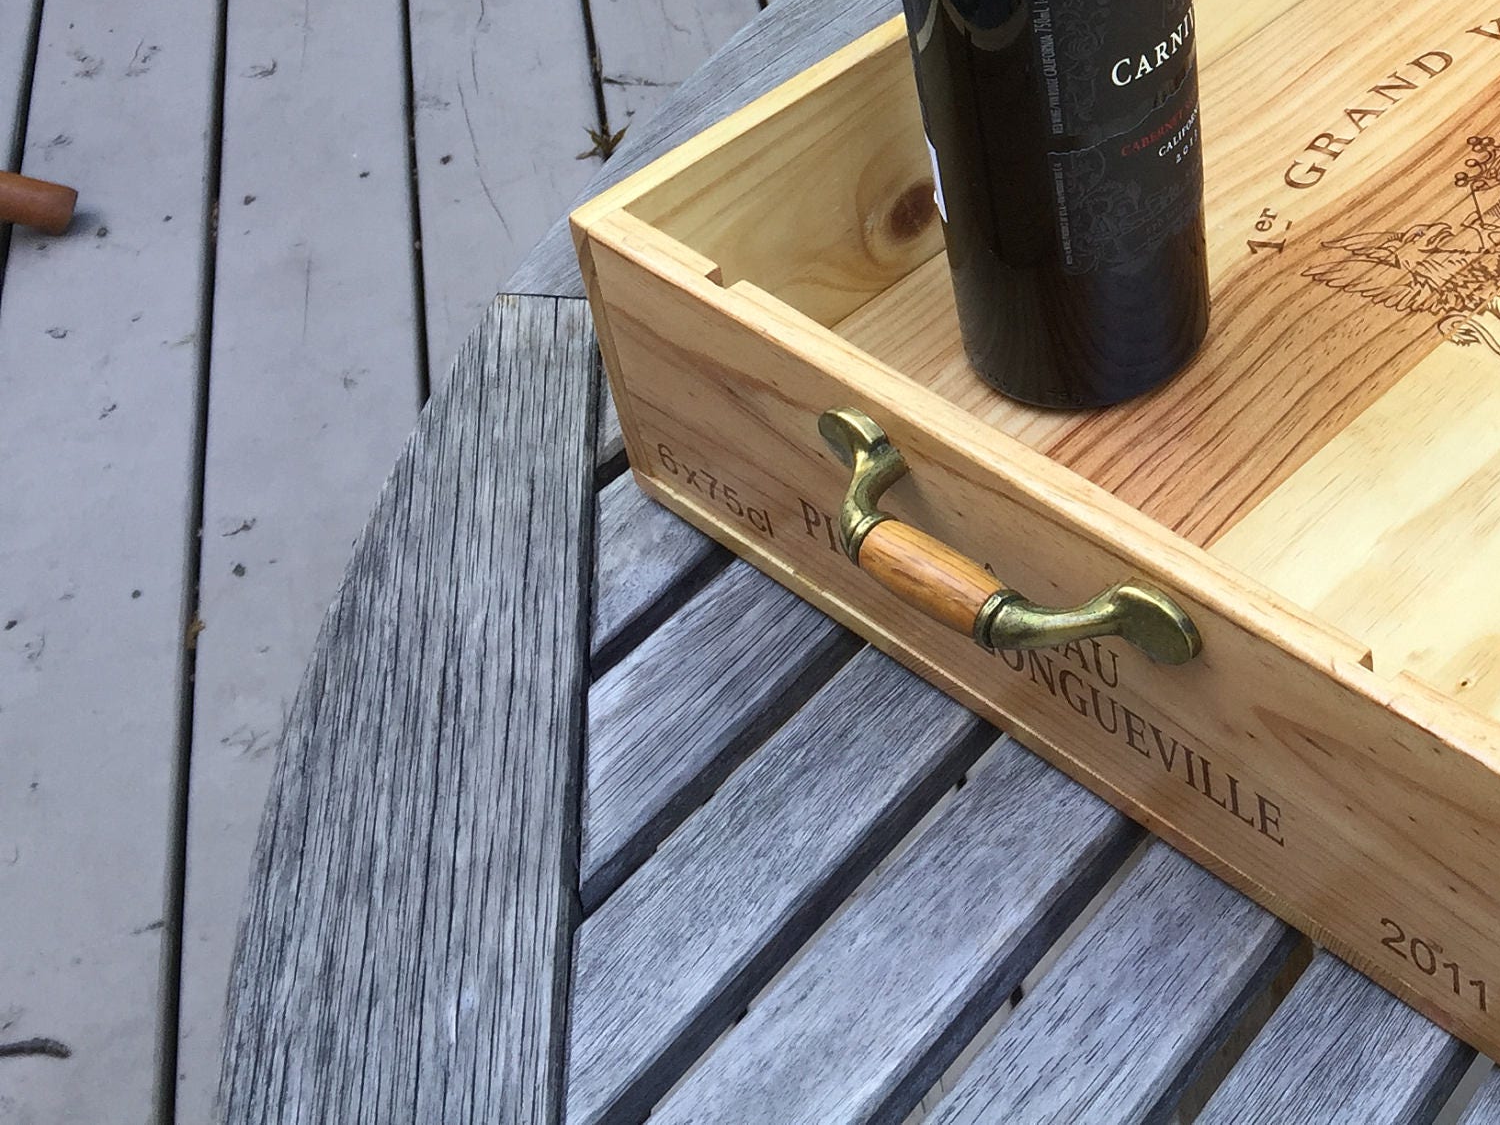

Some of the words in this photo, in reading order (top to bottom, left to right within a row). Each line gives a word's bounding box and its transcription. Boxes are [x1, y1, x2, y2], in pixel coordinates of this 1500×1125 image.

[1033, 7, 1052, 33] 750mL
[1040, 34, 1058, 77] CALIFORNIA
[1284, 51, 1453, 189] GRAND
[657, 443, 775, 538] 6x75cl
[1380, 917, 1487, 1012] 2011
